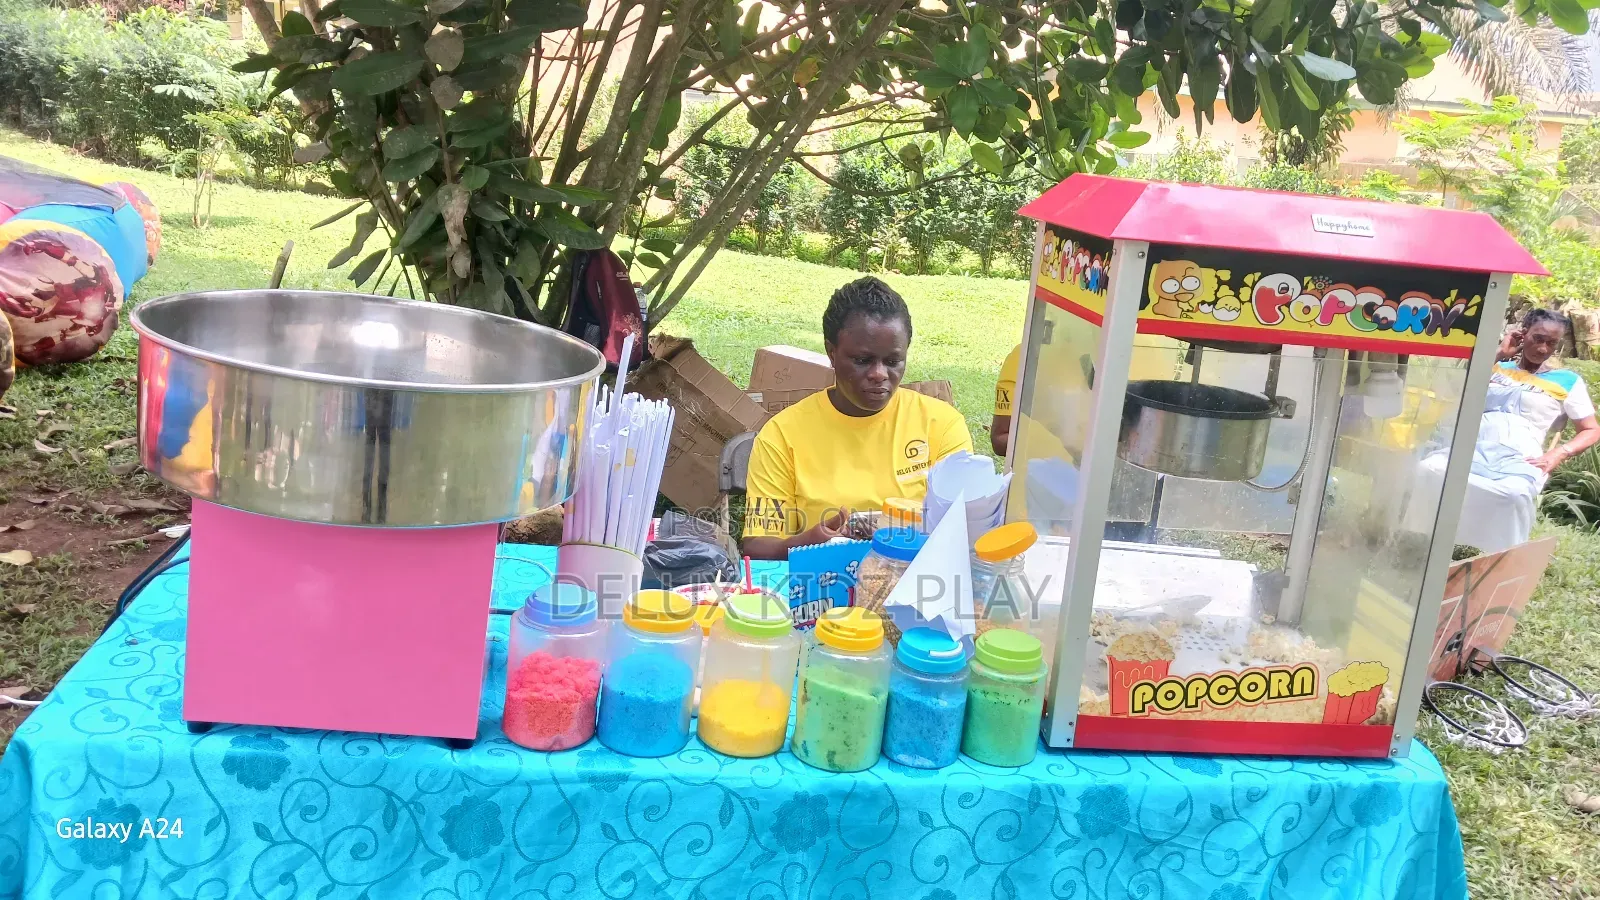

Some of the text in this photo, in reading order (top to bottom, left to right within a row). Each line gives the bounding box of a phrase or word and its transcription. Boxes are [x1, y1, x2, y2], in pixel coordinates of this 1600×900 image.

[1316, 216, 1371, 232] Happyhome
[1251, 272, 1466, 336] POPCORN
[1132, 666, 1315, 713] POPCORN
